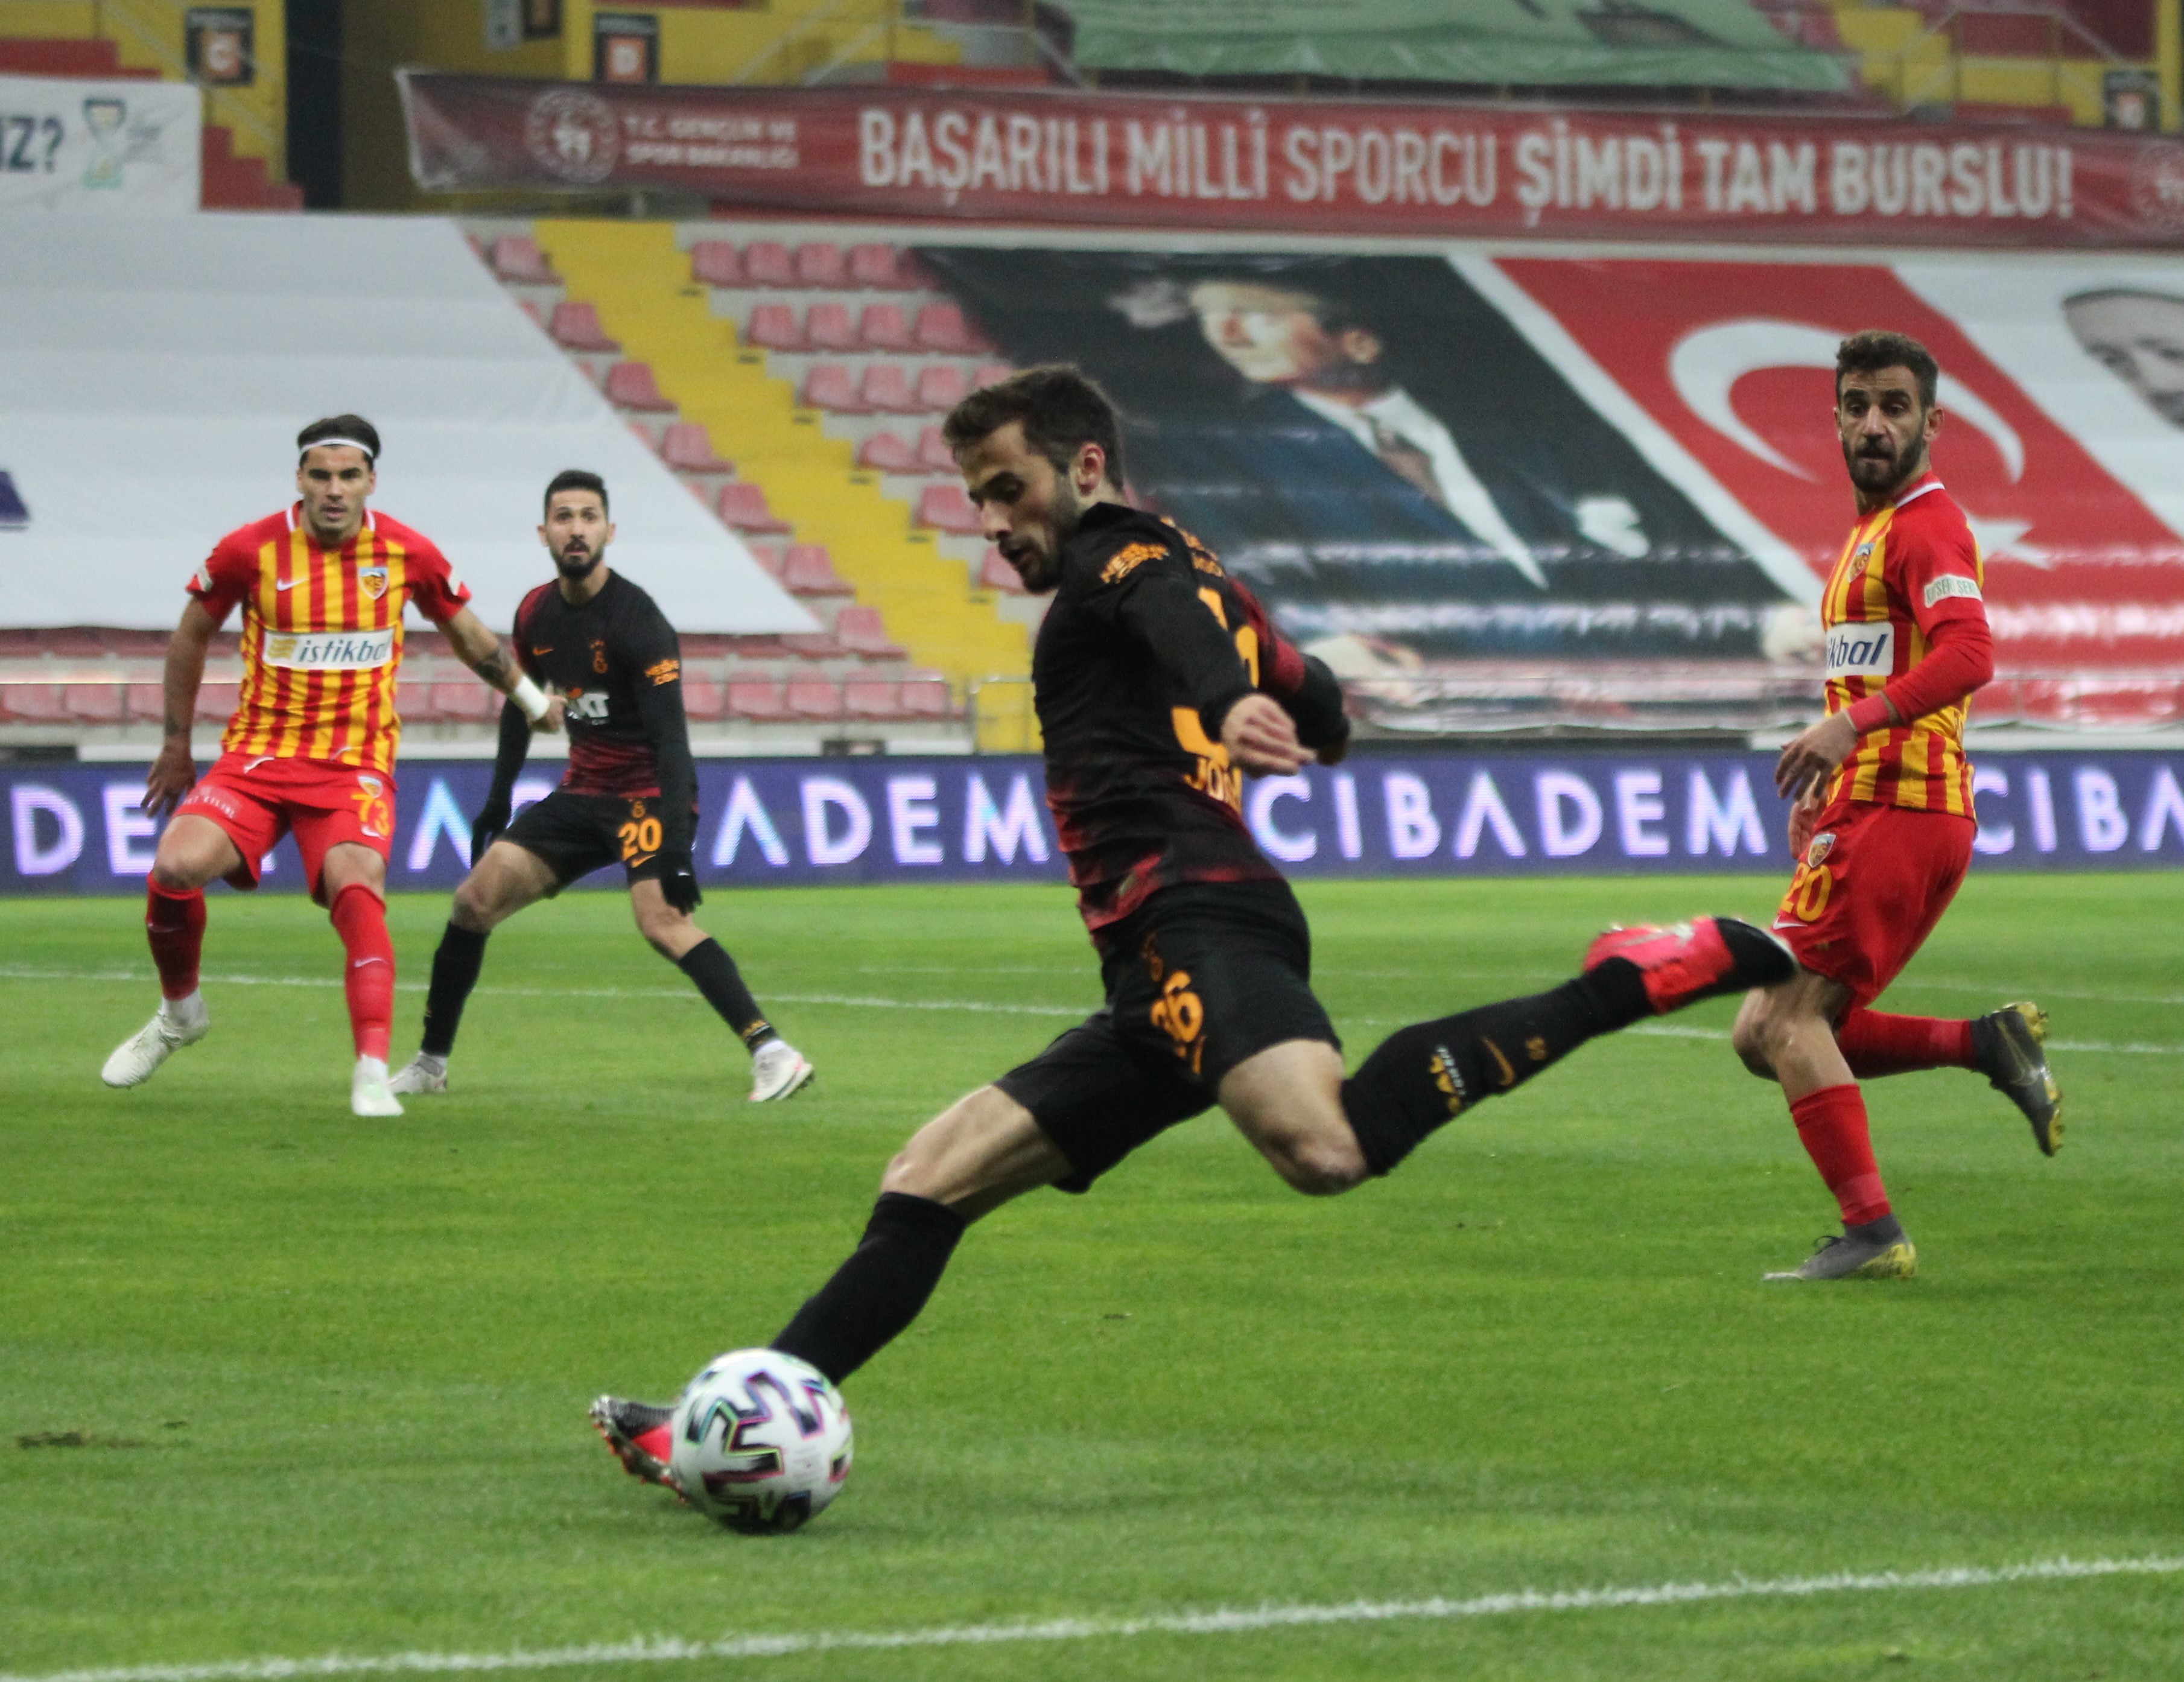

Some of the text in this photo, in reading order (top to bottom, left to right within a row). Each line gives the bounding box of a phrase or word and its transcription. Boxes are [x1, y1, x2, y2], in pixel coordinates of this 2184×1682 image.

[859, 109, 2074, 228] BAŞARILI MİLLİ SPORCU ŞİMDİ TAM BURSLU!
[298, 636, 392, 662] istikba
[351, 793, 390, 837] 73
[1248, 764, 1769, 862] CIBADEM
[1973, 761, 2184, 855] CIBA
[617, 817, 662, 862] 20
[1780, 862, 1832, 922] 20
